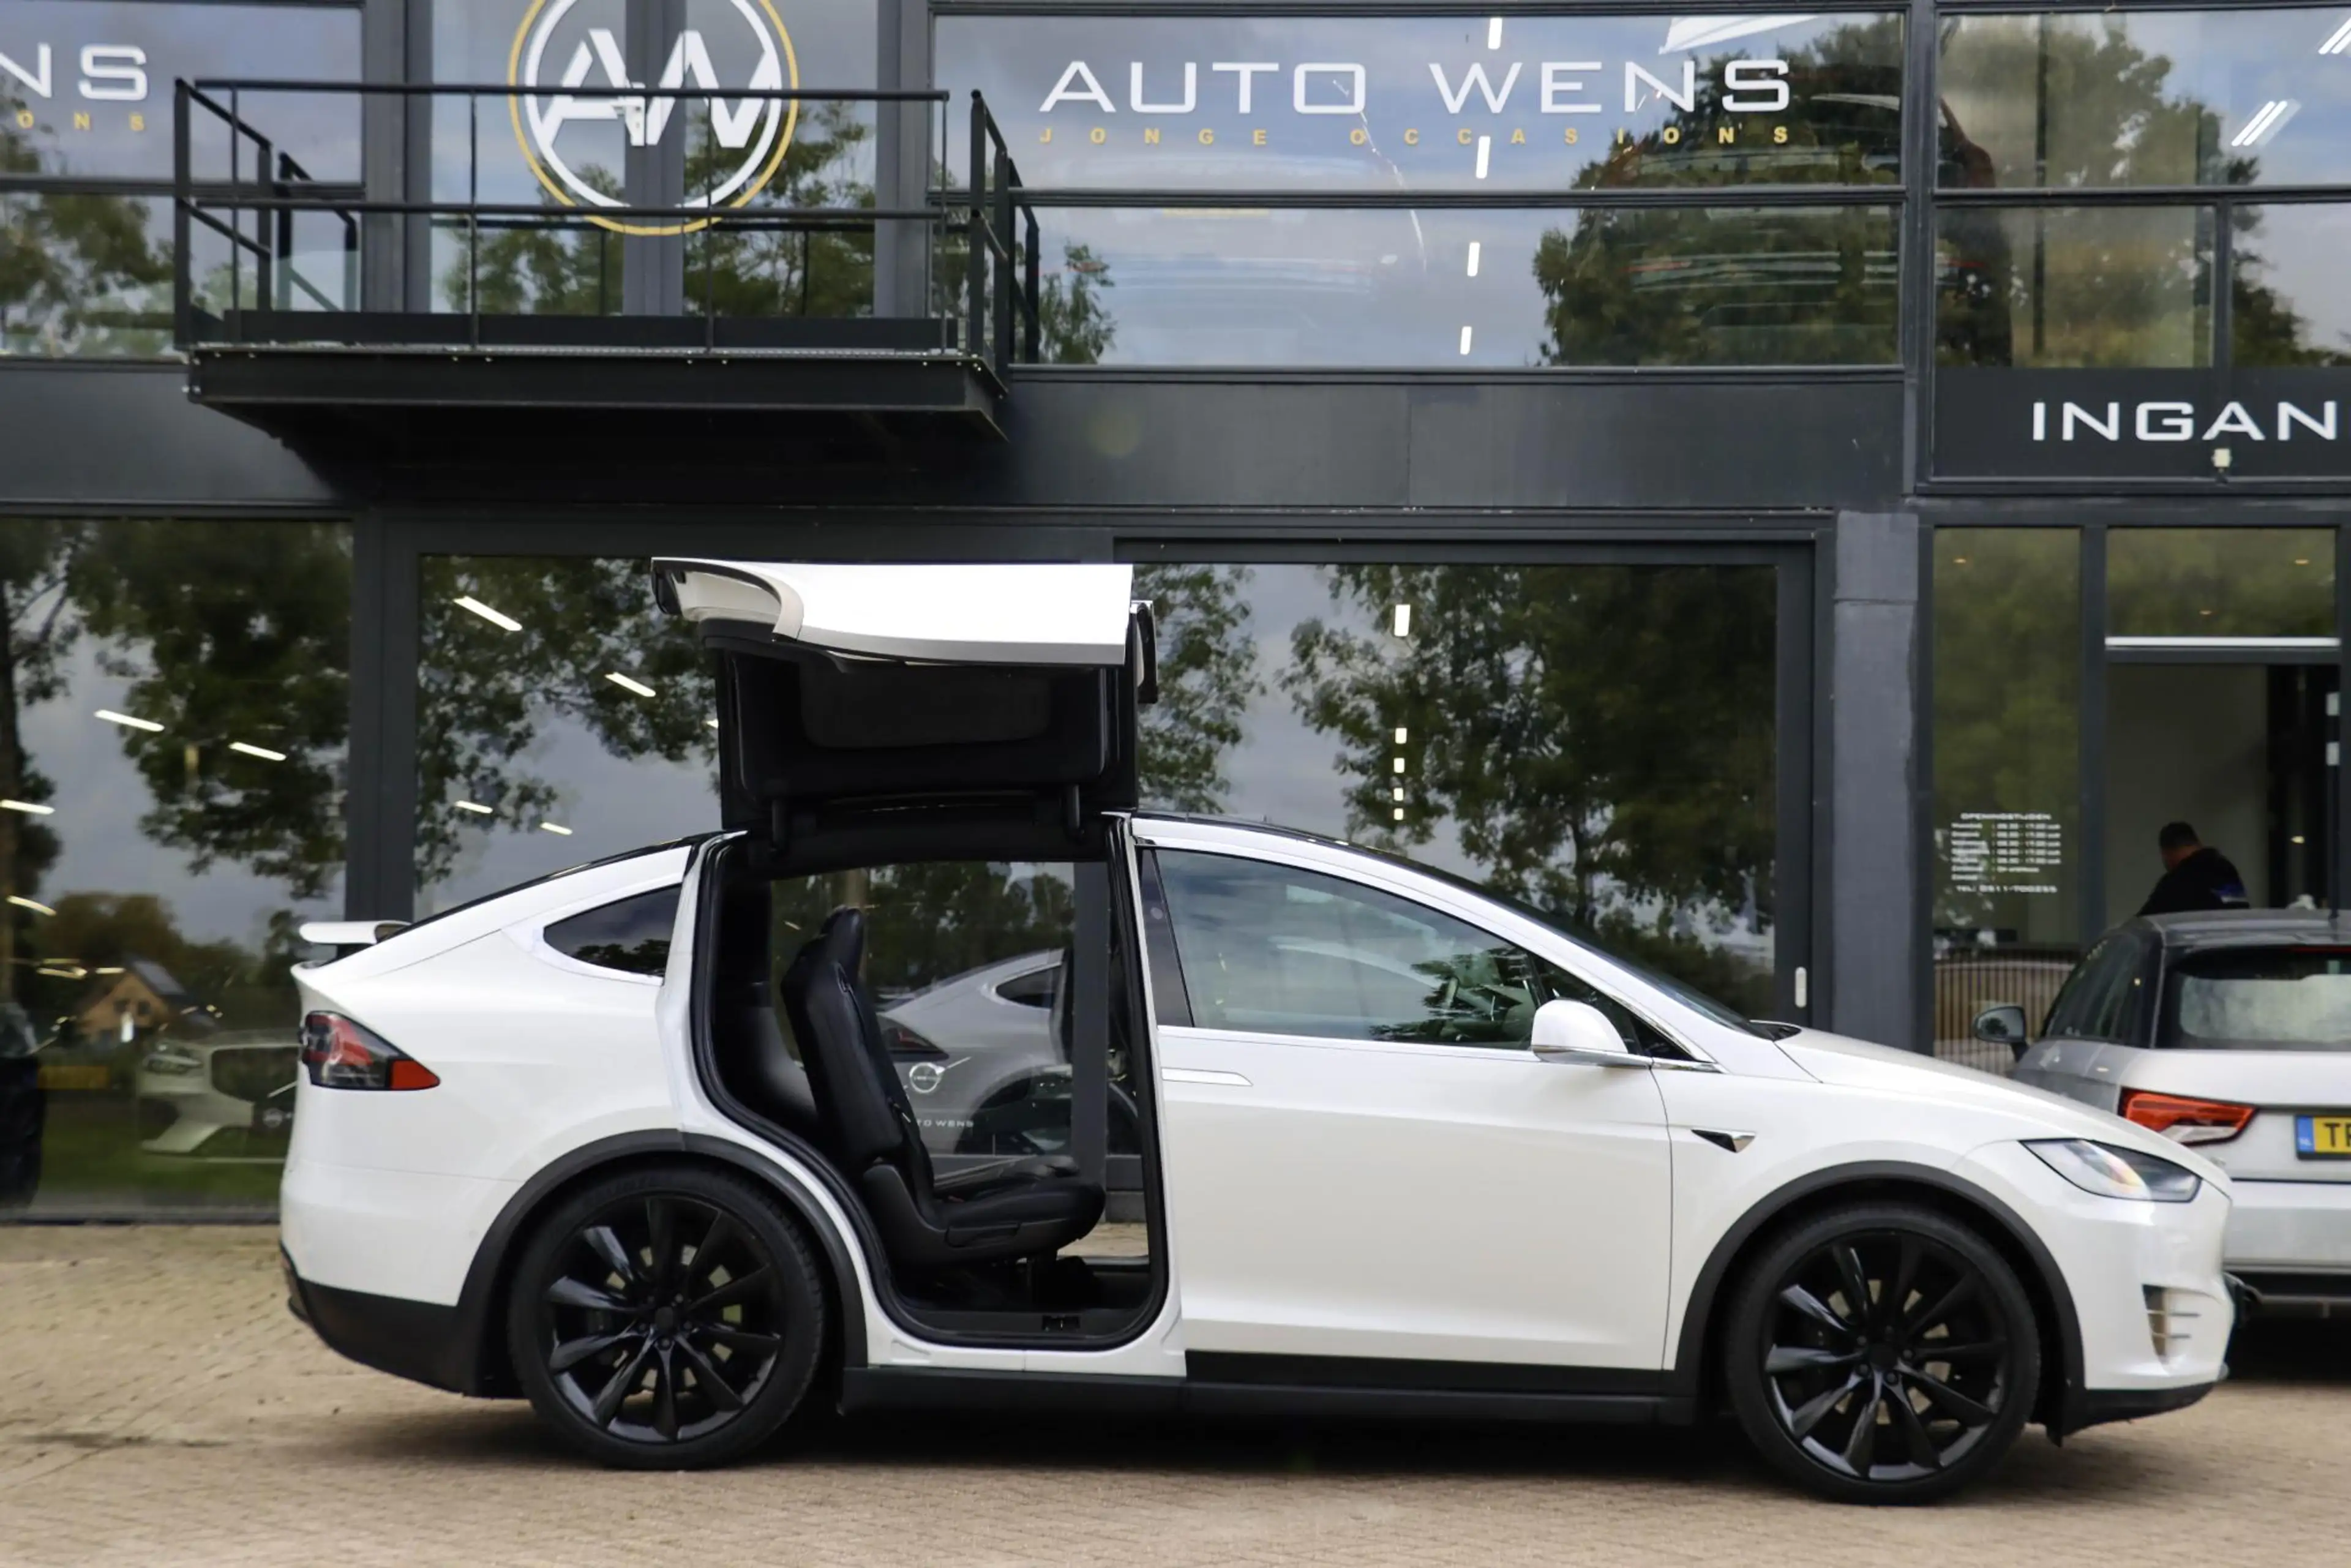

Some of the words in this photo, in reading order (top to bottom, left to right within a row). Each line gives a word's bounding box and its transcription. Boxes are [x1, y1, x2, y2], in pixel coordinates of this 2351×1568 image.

[1039, 61, 1367, 114] AUTO
[1428, 59, 1790, 114] WENS
[1039, 127, 1267, 145] JONGE
[1349, 127, 1789, 146] OCCASIONS
